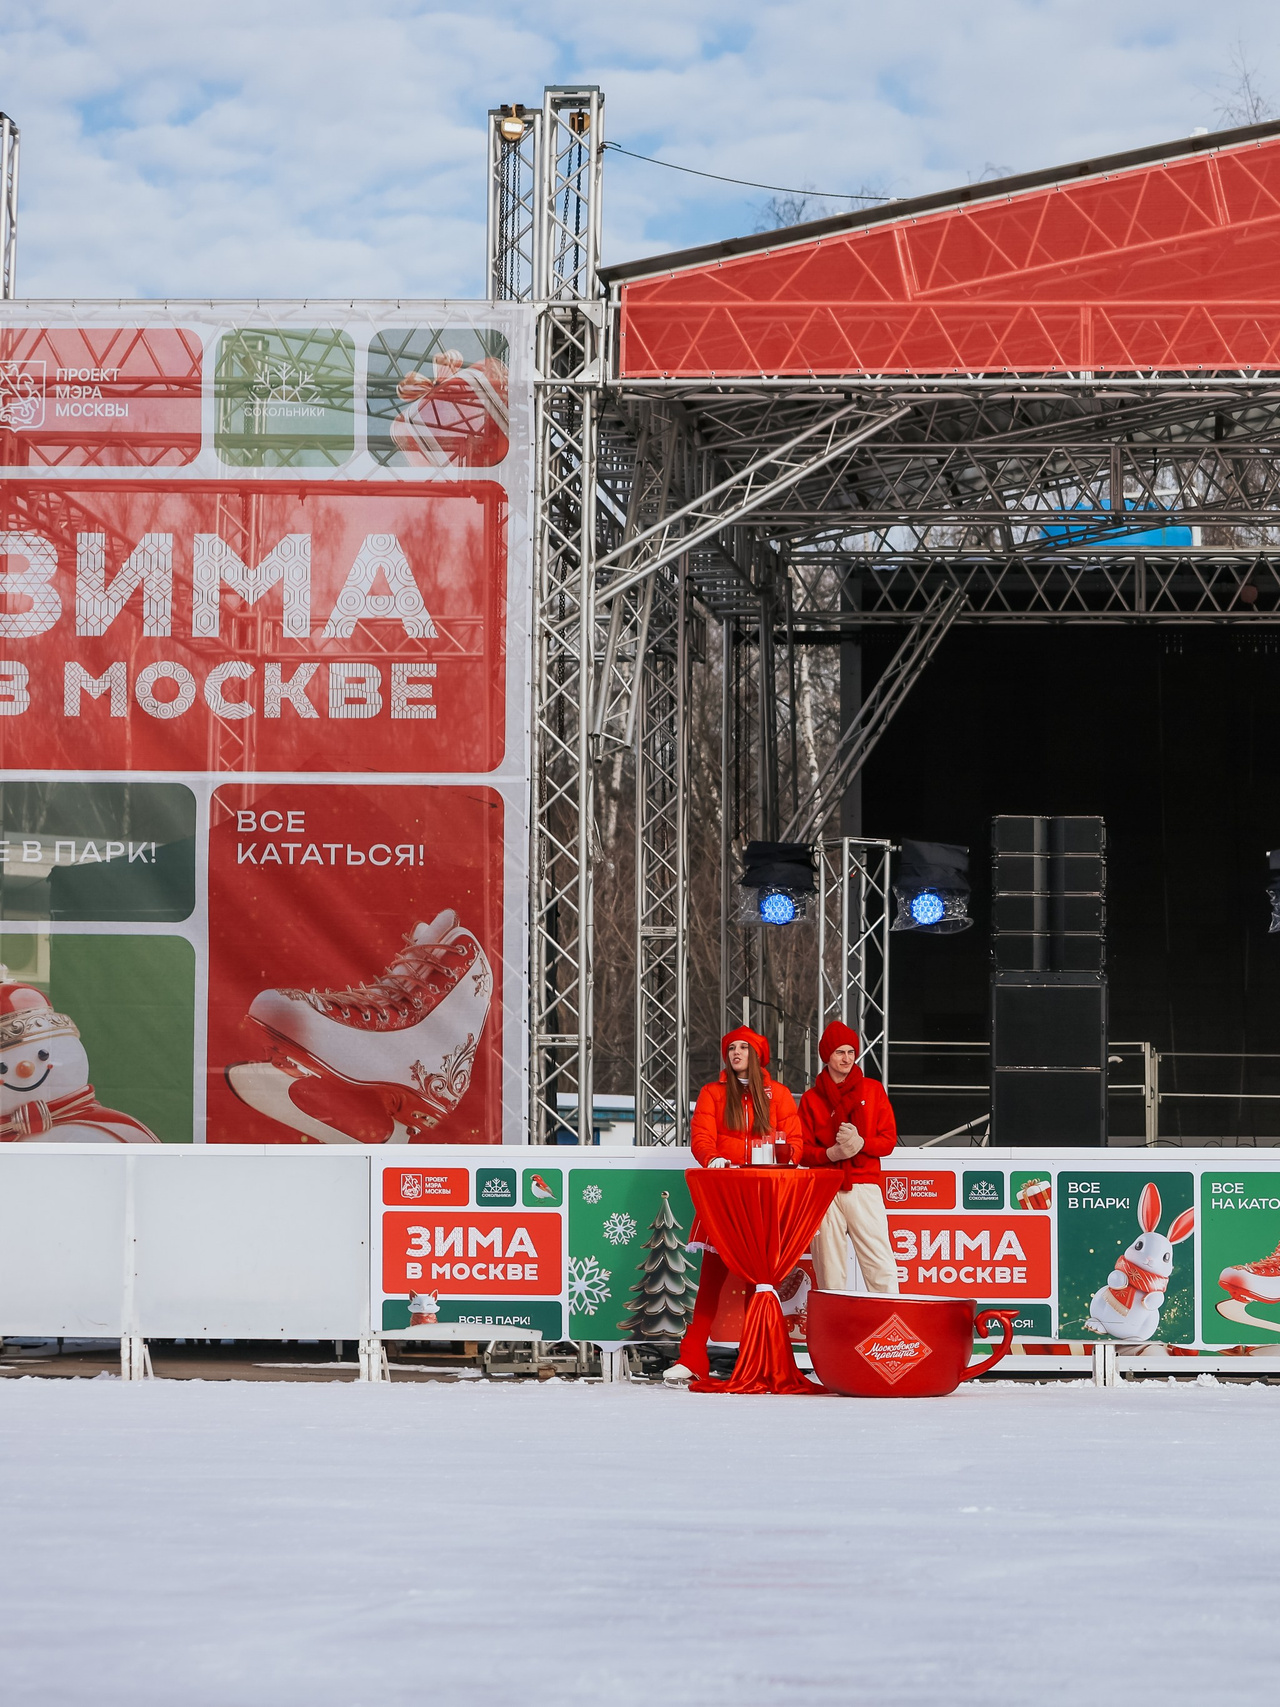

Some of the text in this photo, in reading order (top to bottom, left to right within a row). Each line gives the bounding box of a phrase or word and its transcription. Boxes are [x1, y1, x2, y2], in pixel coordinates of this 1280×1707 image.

[55, 367, 121, 382] ПРОЕКТ
[55, 385, 103, 399] МЭРА
[55, 402, 129, 417] МОСКВЫ
[243, 406, 325, 417] СОКОЛЬНИКИ
[63, 660, 438, 720] МОСКВЕ
[236, 810, 306, 833] ВСЕ
[22, 840, 43, 863] В
[55, 841, 157, 864] ПАРК!
[236, 842, 426, 867] КАТАТЬСЯ!
[1068, 1182, 1100, 1194] ВСЕ
[1211, 1182, 1244, 1194] ВСЕ
[1068, 1197, 1130, 1210] В ПАРК!
[1211, 1198, 1236, 1210] НА
[405, 1225, 539, 1258] ЗИМА
[892, 1229, 1027, 1261] ЗИМА
[406, 1262, 539, 1281] В МОСКВЕ
[897, 1266, 1027, 1283] В МОСКВЕ
[458, 1315, 531, 1326] ВСЕ В ПАРК!
[865, 1341, 920, 1356] Московское
